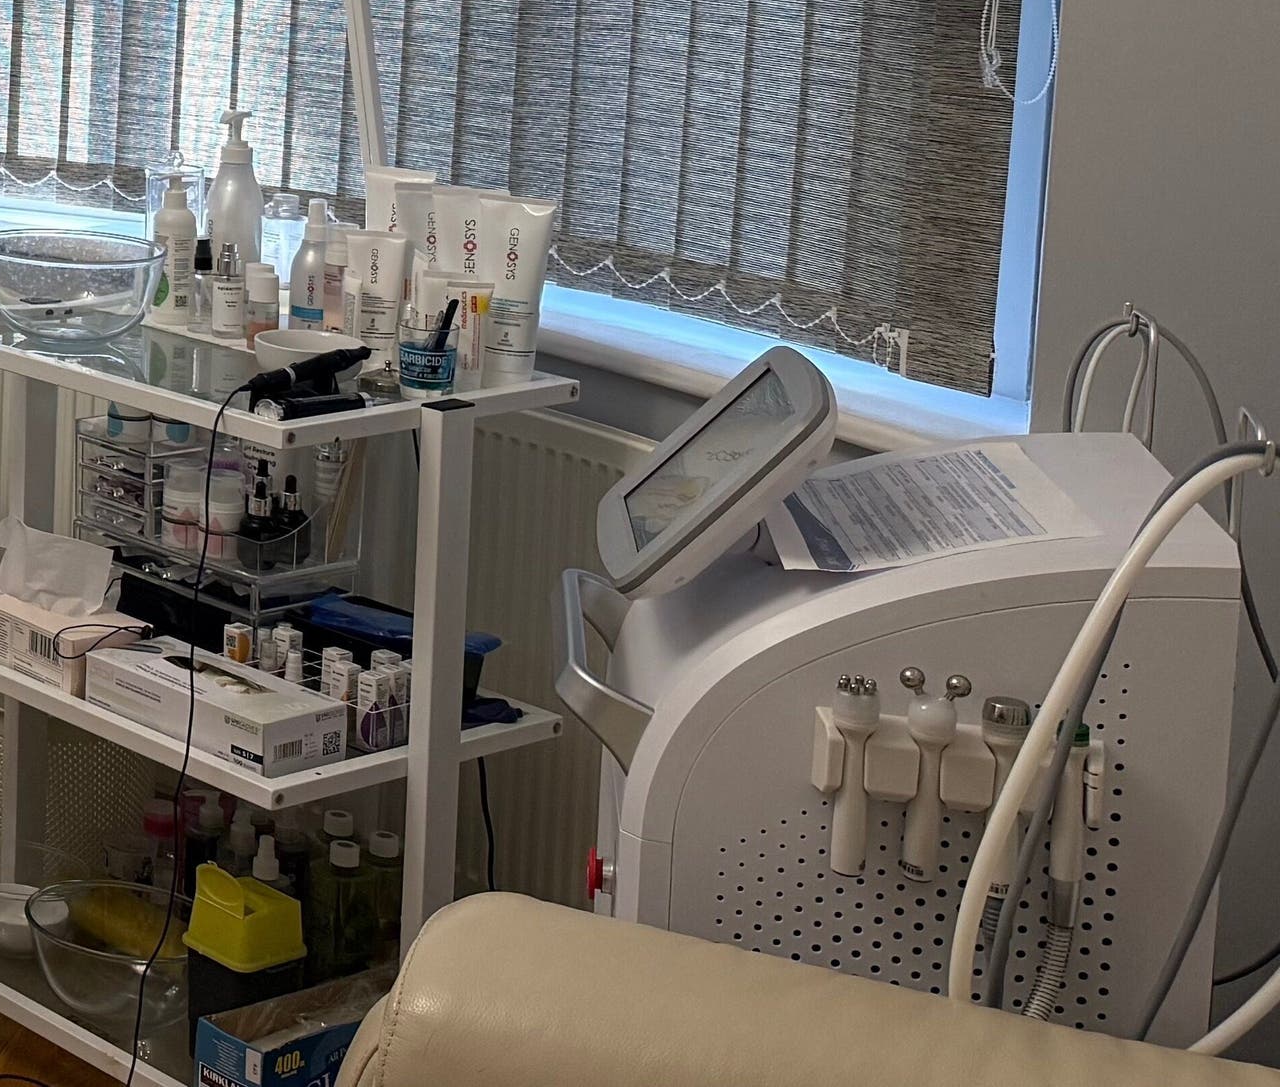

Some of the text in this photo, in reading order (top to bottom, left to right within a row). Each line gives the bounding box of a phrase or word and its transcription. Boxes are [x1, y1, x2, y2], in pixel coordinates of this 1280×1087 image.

[463, 218, 477, 274] ENOSYS
[505, 227, 520, 280] GENOSYS
[370, 248, 379, 285] GENOSYS
[203, 1066, 241, 1087] KIRKLA
[274, 1050, 301, 1075] 400
